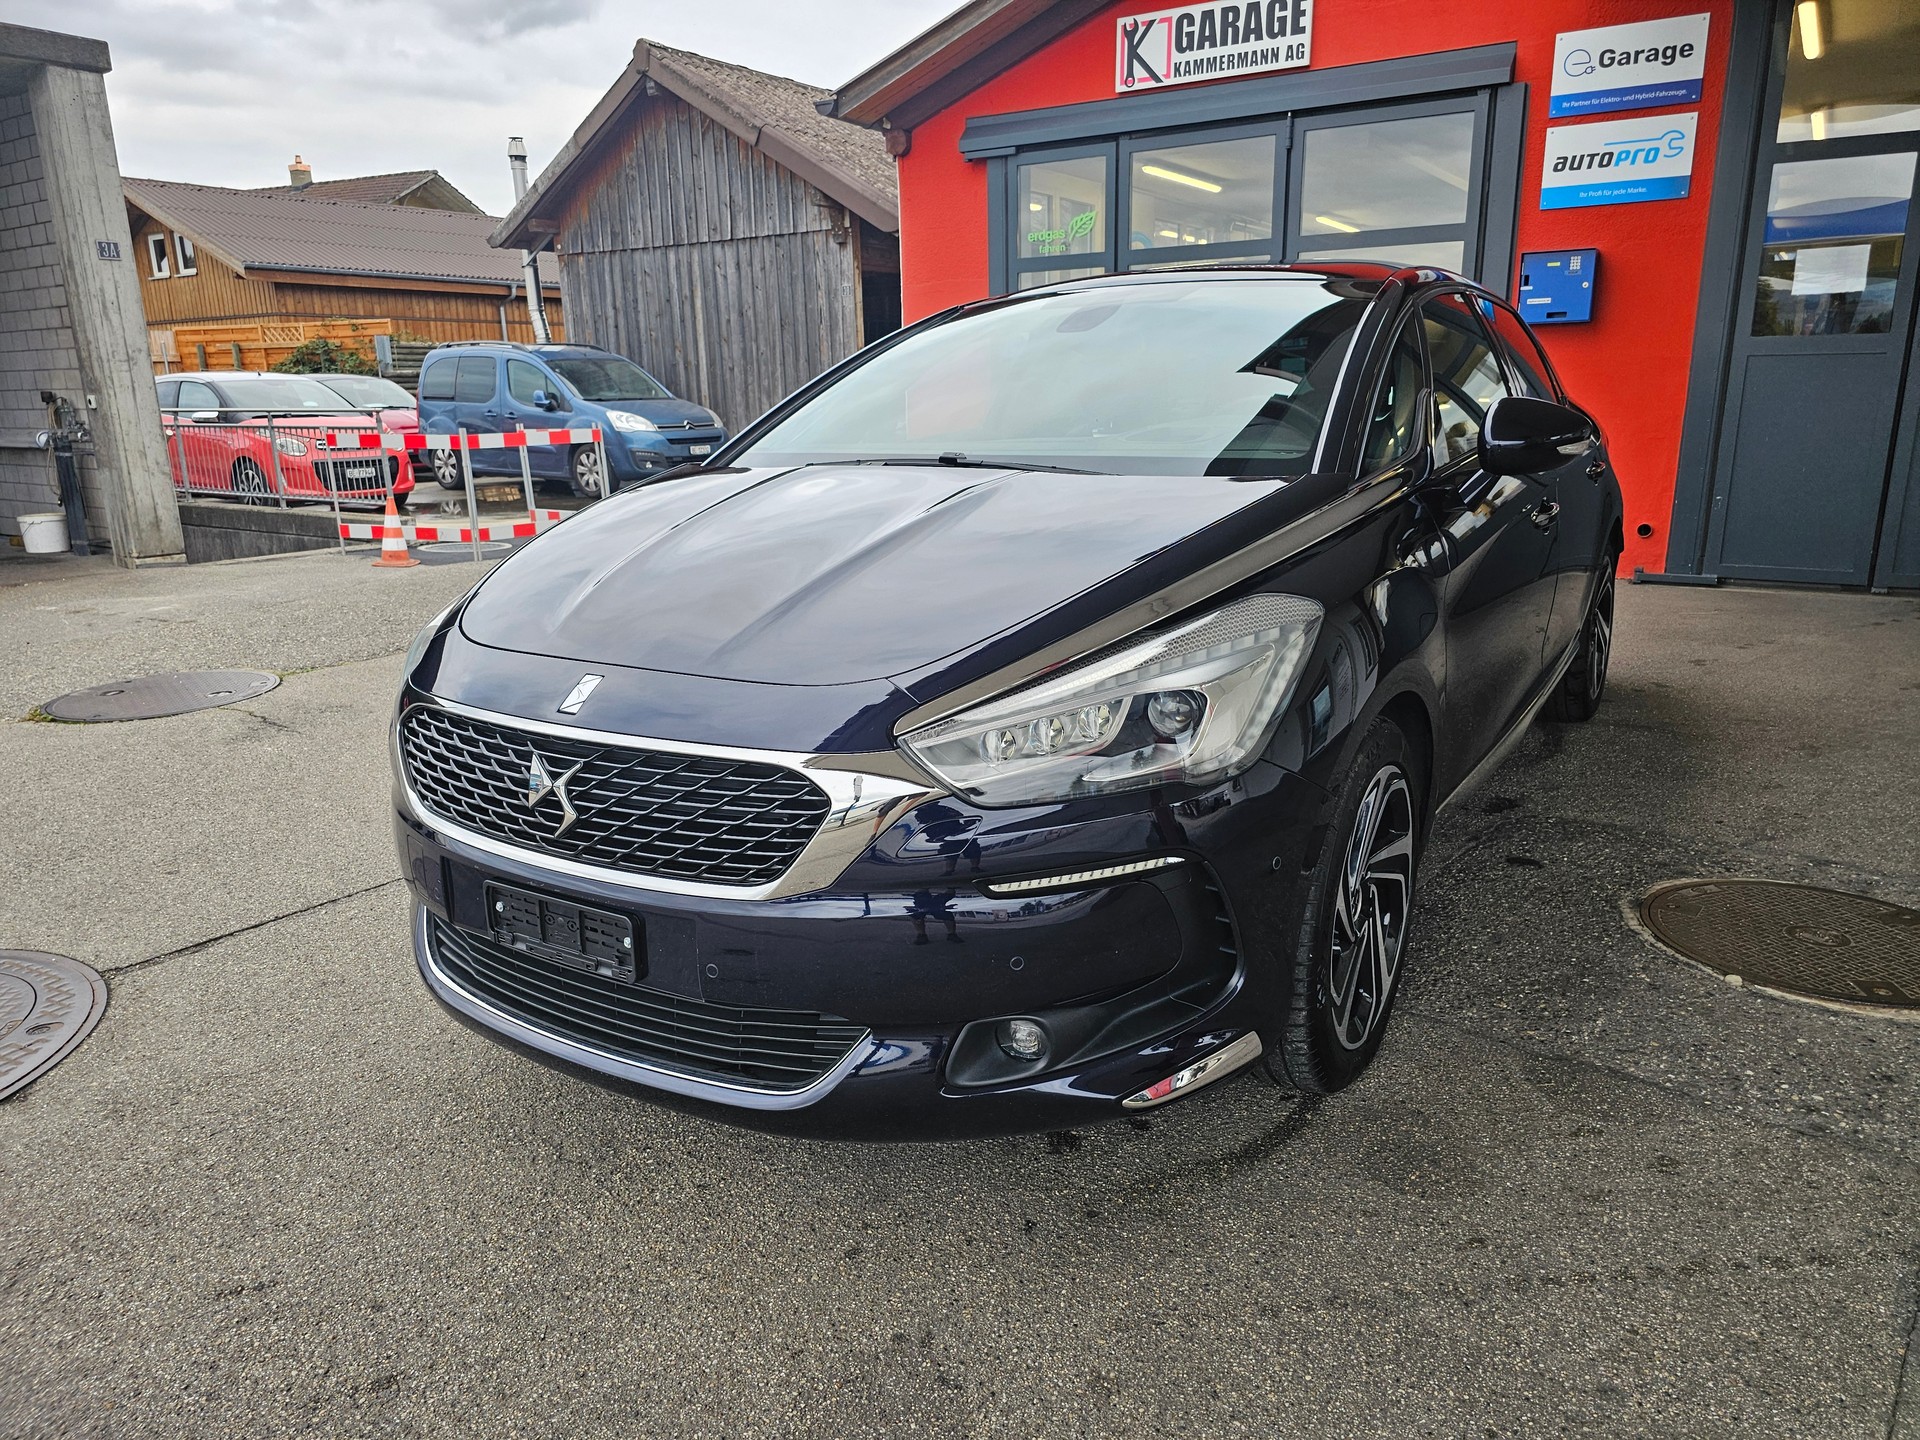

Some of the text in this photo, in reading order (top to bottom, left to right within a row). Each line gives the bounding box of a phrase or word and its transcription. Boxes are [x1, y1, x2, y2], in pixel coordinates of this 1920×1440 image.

[1174, 0, 1306, 54] GARAGE
[1173, 42, 1305, 78] KAMMERMANN AG
[1598, 42, 1694, 69] Garage
[1570, 99, 1591, 107] Partner
[1600, 96, 1621, 104] Elektro-
[1635, 89, 1687, 100] Hybrid-Fahrzeuge.
[1612, 188, 1626, 196] jede
[1627, 186, 1647, 194] Marke.
[1027, 229, 1065, 242] erdgas
[102, 242, 117, 257] 3A
[1039, 244, 1065, 254] fahren
